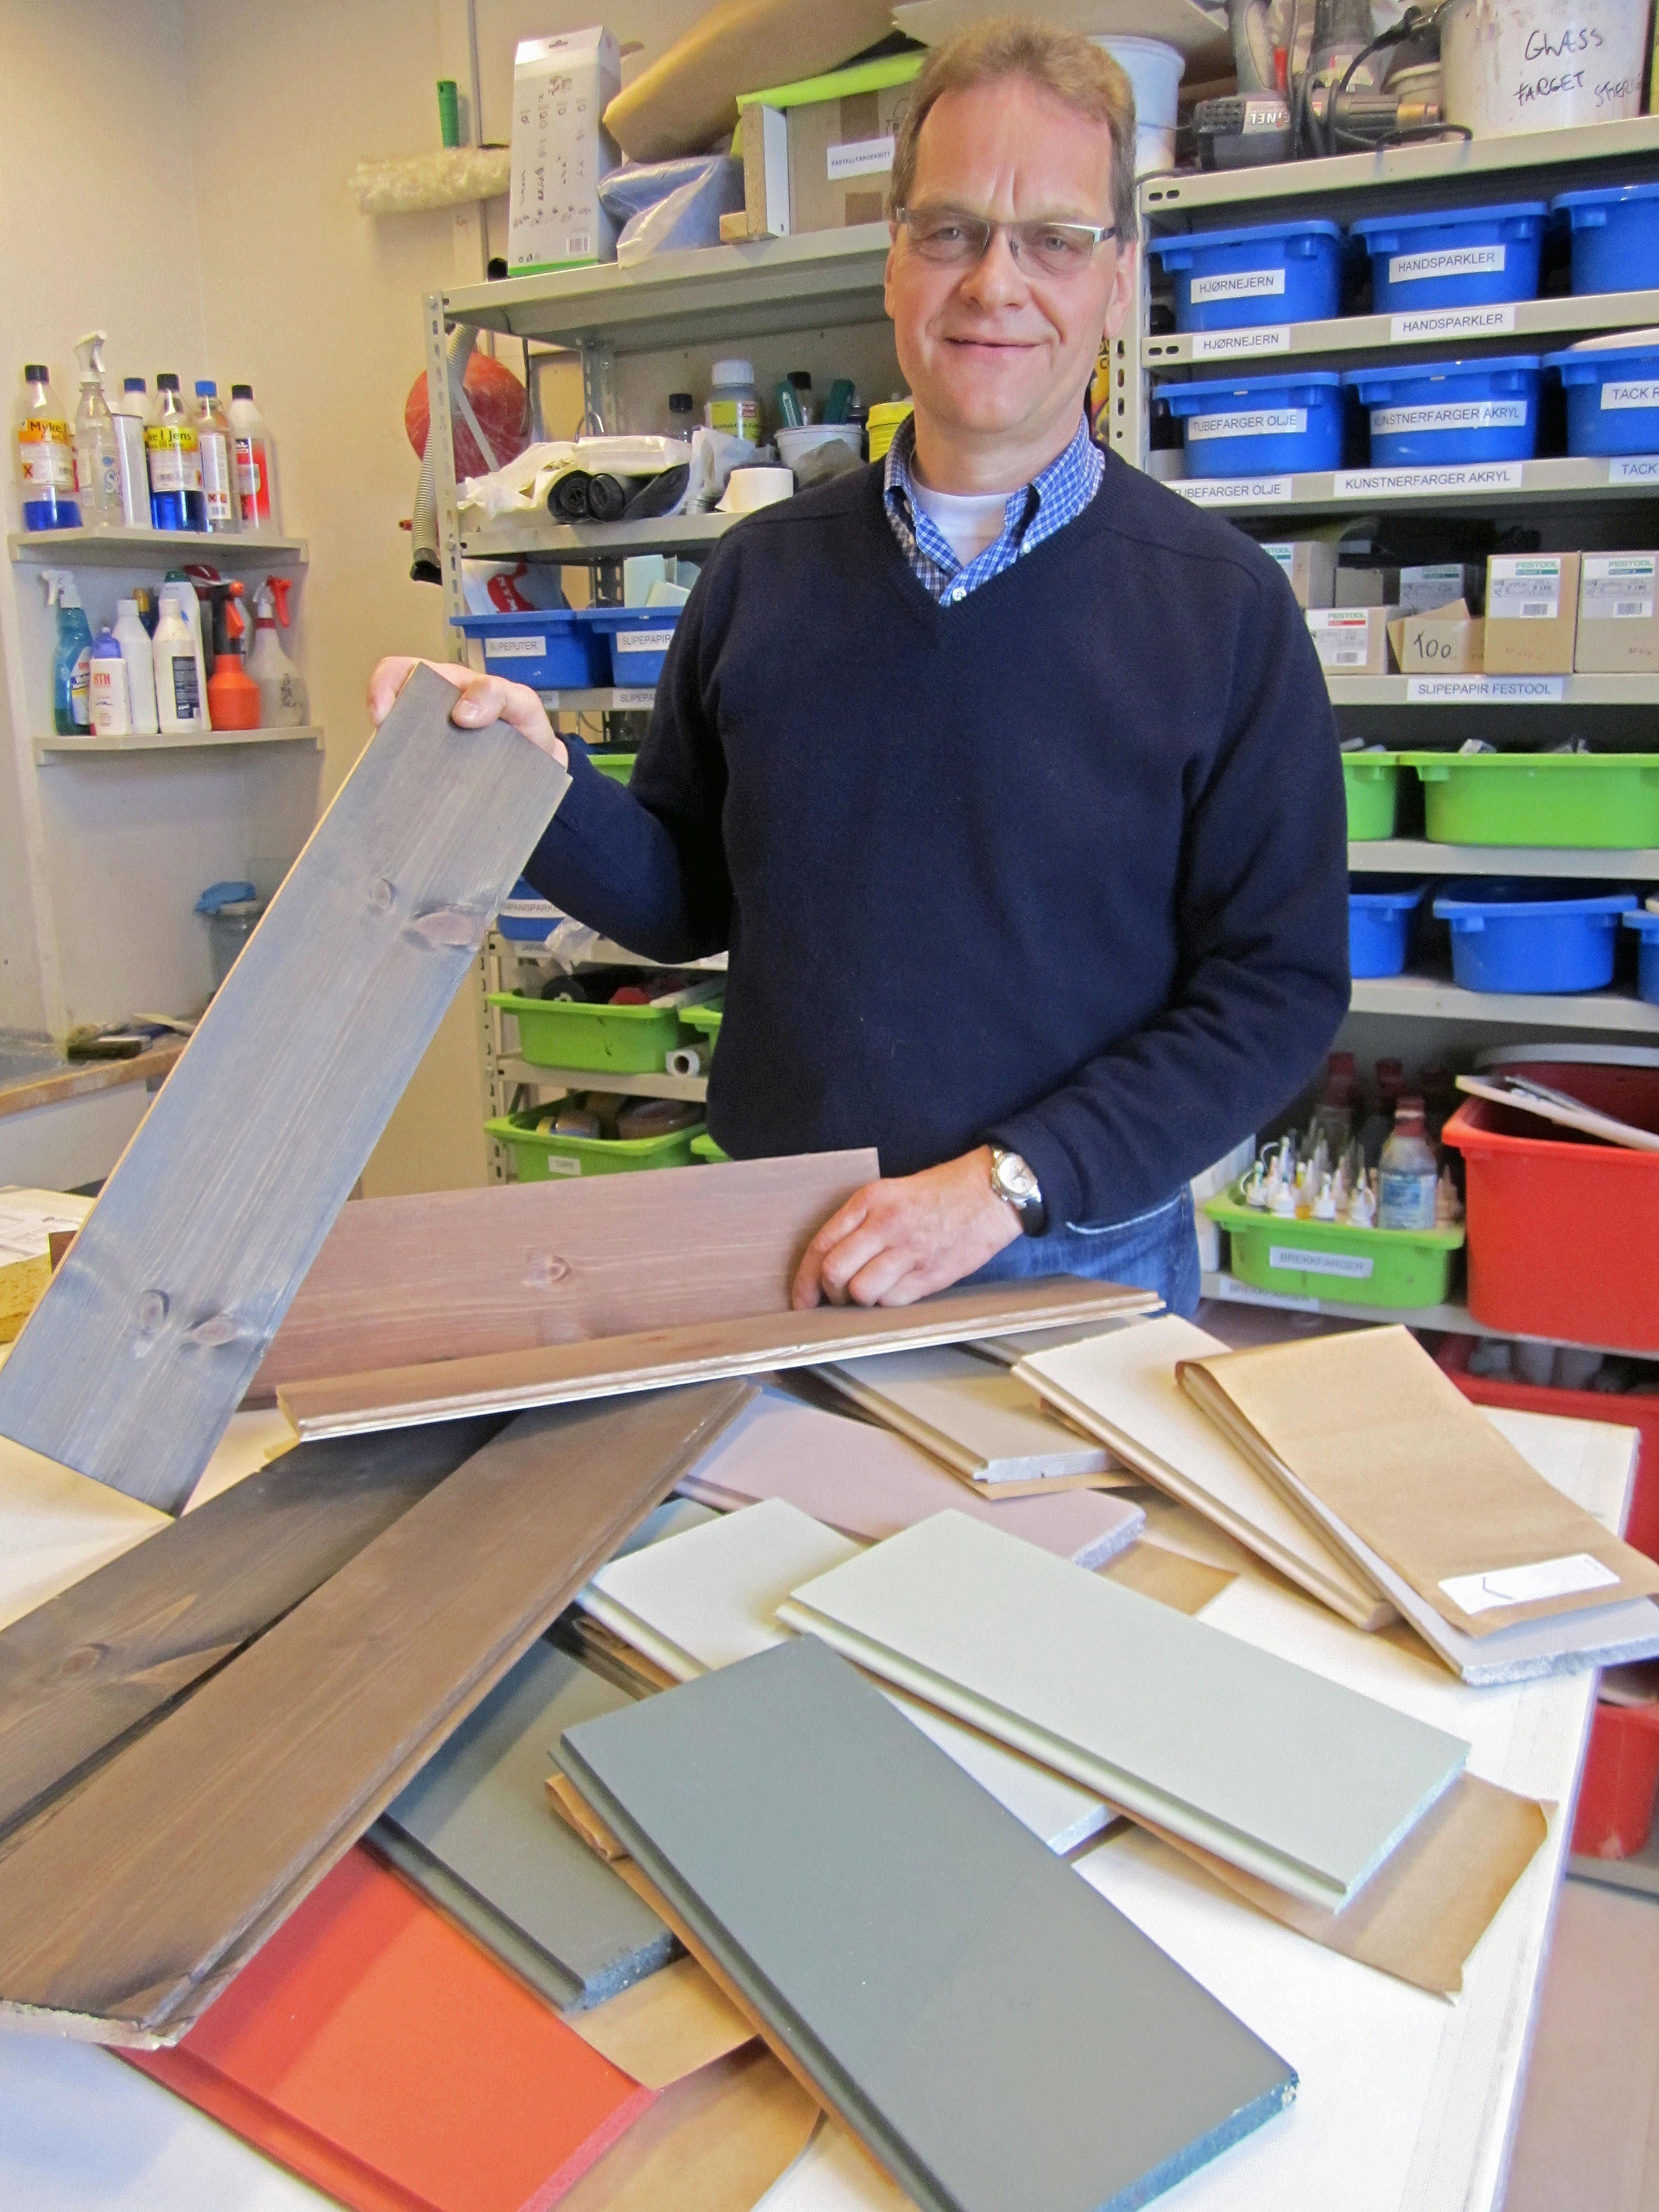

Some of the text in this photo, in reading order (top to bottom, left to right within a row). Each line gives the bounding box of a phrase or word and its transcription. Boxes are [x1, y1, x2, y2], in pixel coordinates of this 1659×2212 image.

[1524, 29, 1603, 60] GLASS
[1398, 252, 1495, 273] HANDSPARKLER
[1200, 276, 1274, 293] HJØRNEJERN
[1403, 313, 1503, 332] HANDSPARKLER
[1203, 333, 1279, 350] HJØRNEJERN
[1613, 387, 1649, 400] TACK
[1194, 415, 1297, 432] TUBEFARGER OLJE
[1374, 407, 1519, 427] KUNSTNERFARGER AKRYL
[1622, 463, 1657, 476] TACK
[1345, 470, 1510, 490] KUNSTNERFARGER AKRYL
[1252, 484, 1282, 496] OLJE
[622, 634, 671, 645] SLIPEPAPIR
[1413, 630, 1452, 659] 100
[1418, 684, 1551, 695] SLIPEPAPIR FESTOOL
